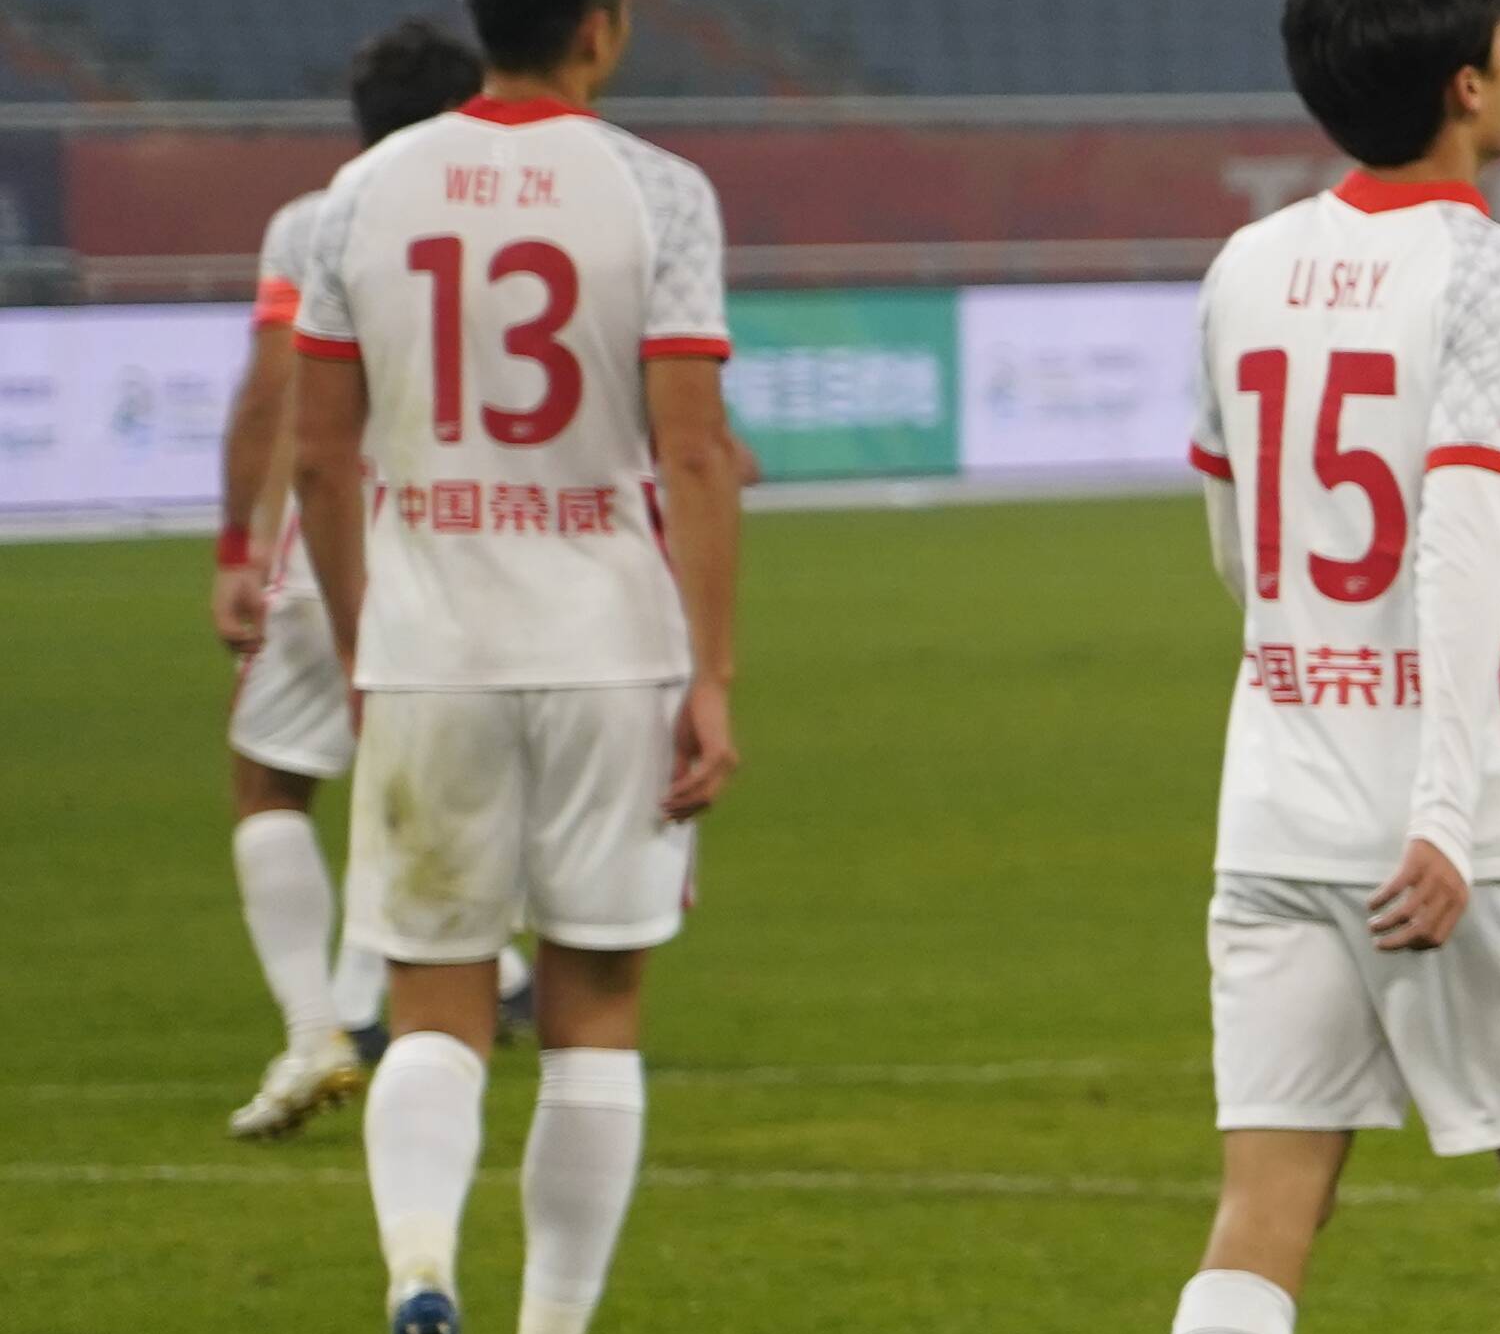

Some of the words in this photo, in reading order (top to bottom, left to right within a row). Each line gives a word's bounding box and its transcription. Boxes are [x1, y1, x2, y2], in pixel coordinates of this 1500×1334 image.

[445, 164, 500, 207] WEI
[1286, 258, 1317, 307] LI
[407, 235, 583, 447] 13
[1236, 347, 1408, 603] 15
[396, 479, 618, 535] 中国荣威
